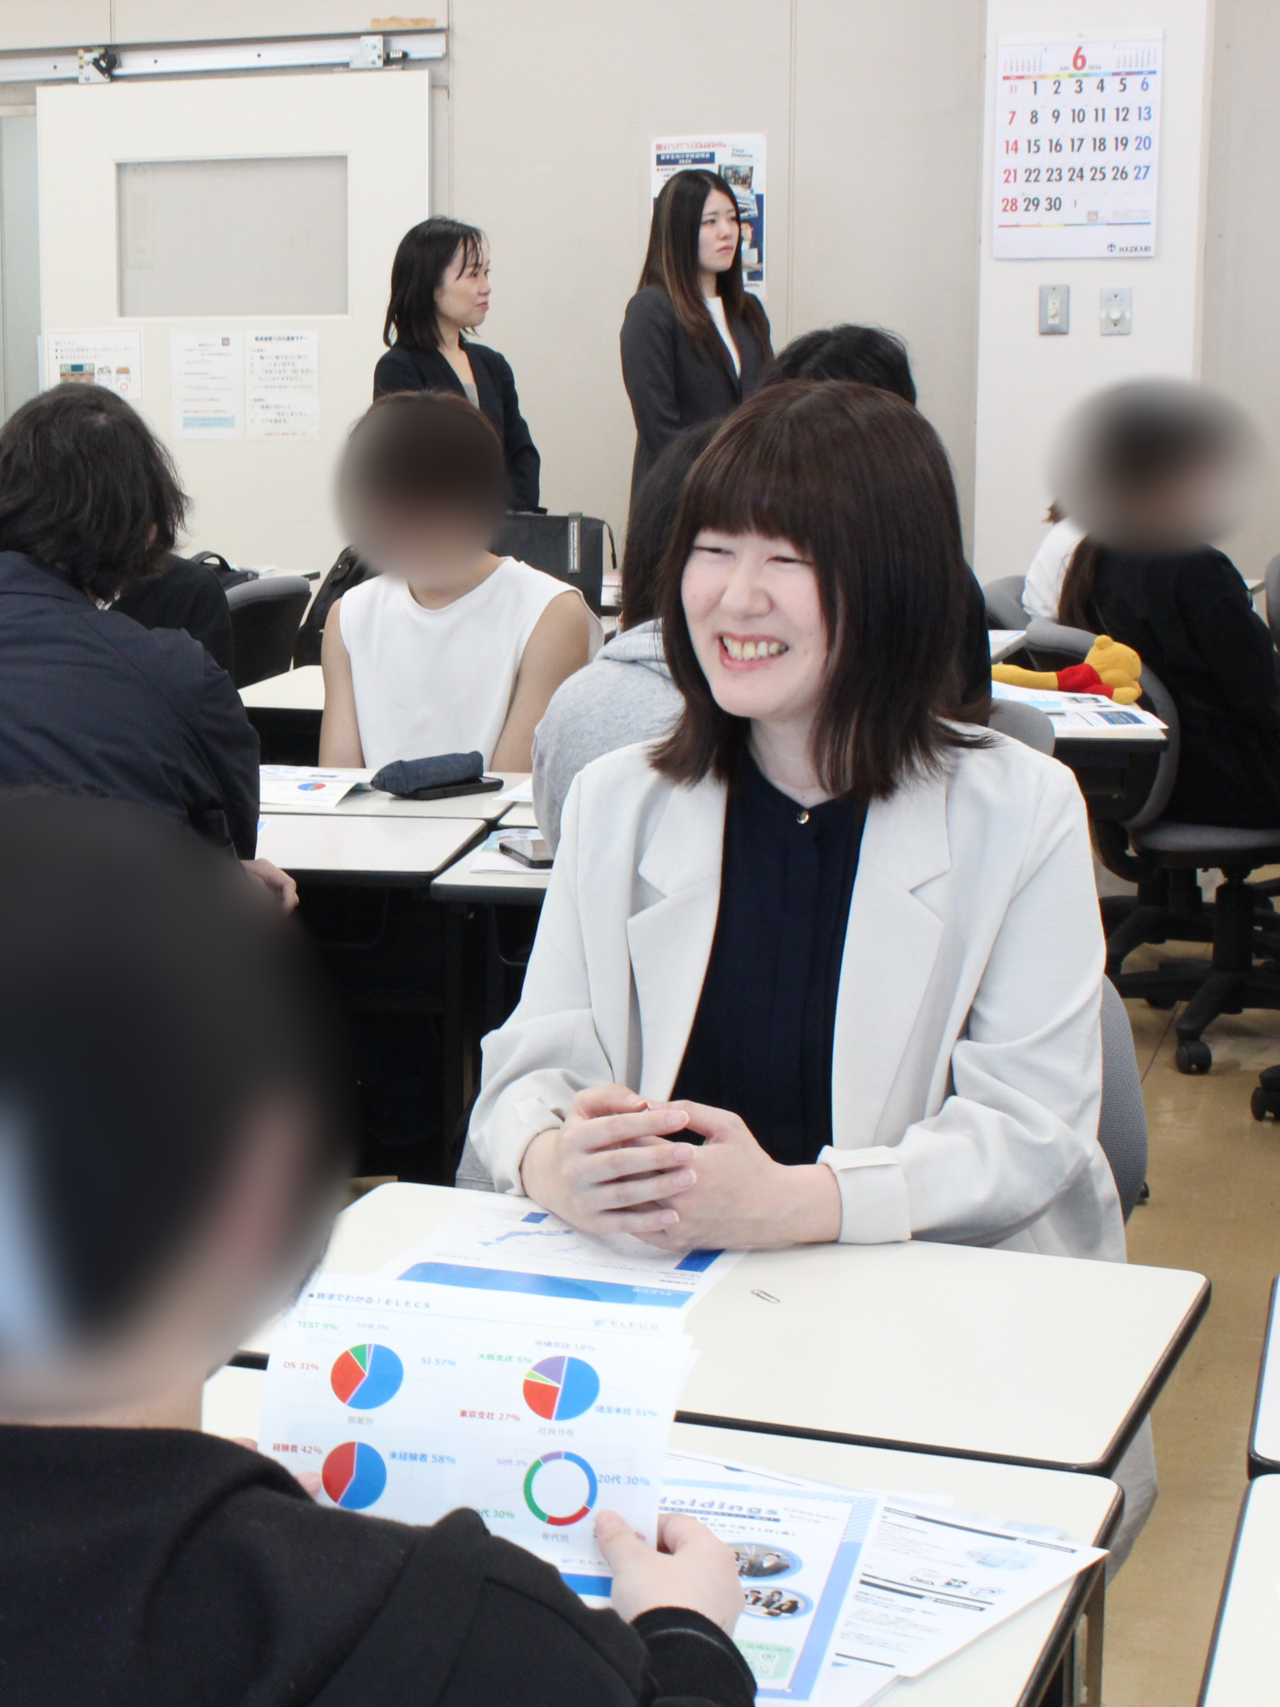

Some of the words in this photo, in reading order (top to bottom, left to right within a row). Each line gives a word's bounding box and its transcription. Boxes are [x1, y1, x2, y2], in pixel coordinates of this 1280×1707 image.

[1072, 46, 1086, 71] 6
[1008, 84, 1018, 94] 31
[1032, 80, 1038, 95] 1
[1052, 80, 1062, 95] 2
[1074, 79, 1083, 94] 3
[1096, 78, 1105, 93] 4
[1118, 77, 1127, 93] 5
[1140, 77, 1149, 91] 6
[1008, 110, 1017, 125] 7
[1029, 110, 1039, 125] 8
[1051, 109, 1061, 124] 9
[1070, 108, 1086, 123] 10
[1094, 108, 1106, 123] 11
[1115, 107, 1130, 122] 12
[1137, 106, 1152, 121] 13
[1004, 139, 1019, 155] 14
[1026, 139, 1041, 154] 15
[1048, 138, 1063, 153] 16
[1070, 138, 1084, 153] 17
[1091, 137, 1107, 152] 18
[1114, 136, 1129, 151] 19
[1134, 136, 1152, 151] 20
[1003, 169, 1017, 184] 21
[1024, 168, 1041, 183] 22
[1046, 167, 1063, 182] 23
[1067, 167, 1085, 182] 24
[1089, 166, 1106, 181] 25
[1111, 165, 1128, 181] 26
[1133, 165, 1151, 180] 27
[1001, 198, 1018, 212] 28
[1023, 197, 1040, 212] 29
[1044, 196, 1062, 211] 30
[297, 1321, 319, 1329] TEST
[434, 1358, 457, 1367] 57%
[477, 1352, 513, 1362] 大阪支店
[298, 1362, 320, 1371] 31%
[498, 1411, 520, 1422] 27%
[272, 1443, 298, 1453] 経験者
[301, 1445, 323, 1455] 42%
[389, 1451, 428, 1463] 未経験者
[431, 1454, 456, 1465] 58%
[597, 1474, 622, 1485] 20代
[624, 1477, 651, 1487] 30%
[492, 1510, 516, 1520] 30%
